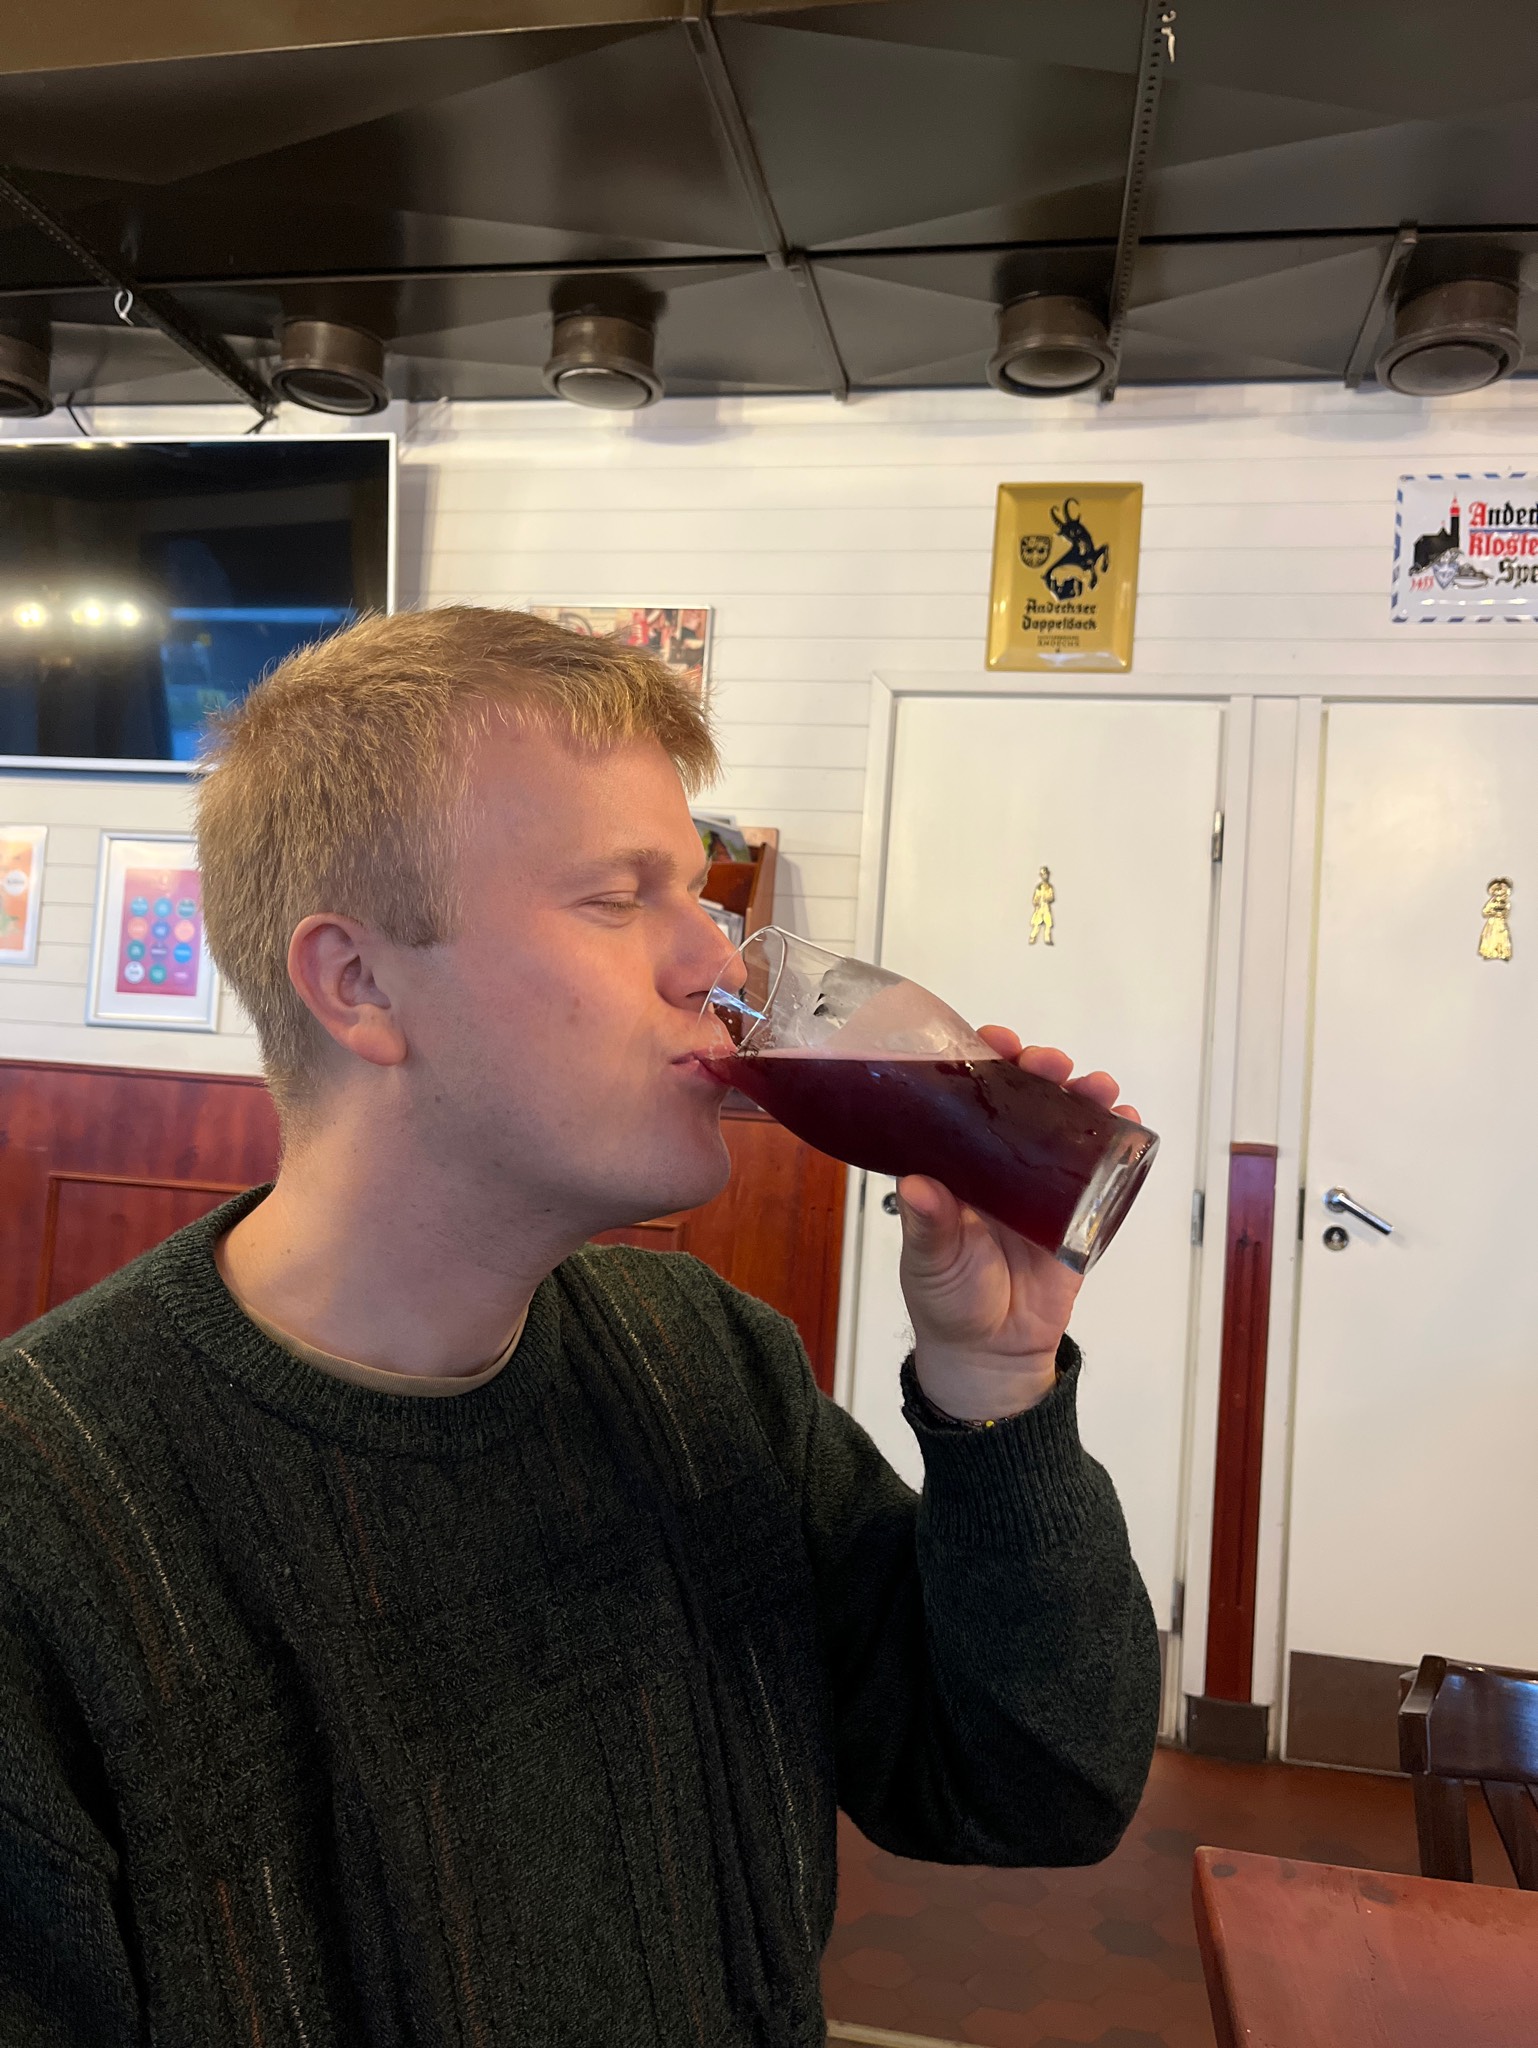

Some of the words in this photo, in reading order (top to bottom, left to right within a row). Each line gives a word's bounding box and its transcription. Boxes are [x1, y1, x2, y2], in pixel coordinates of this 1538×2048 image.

[1468, 500, 1538, 527] Andec
[1025, 599, 1097, 614] Andechser
[1022, 616, 1097, 632] Doppelbock
